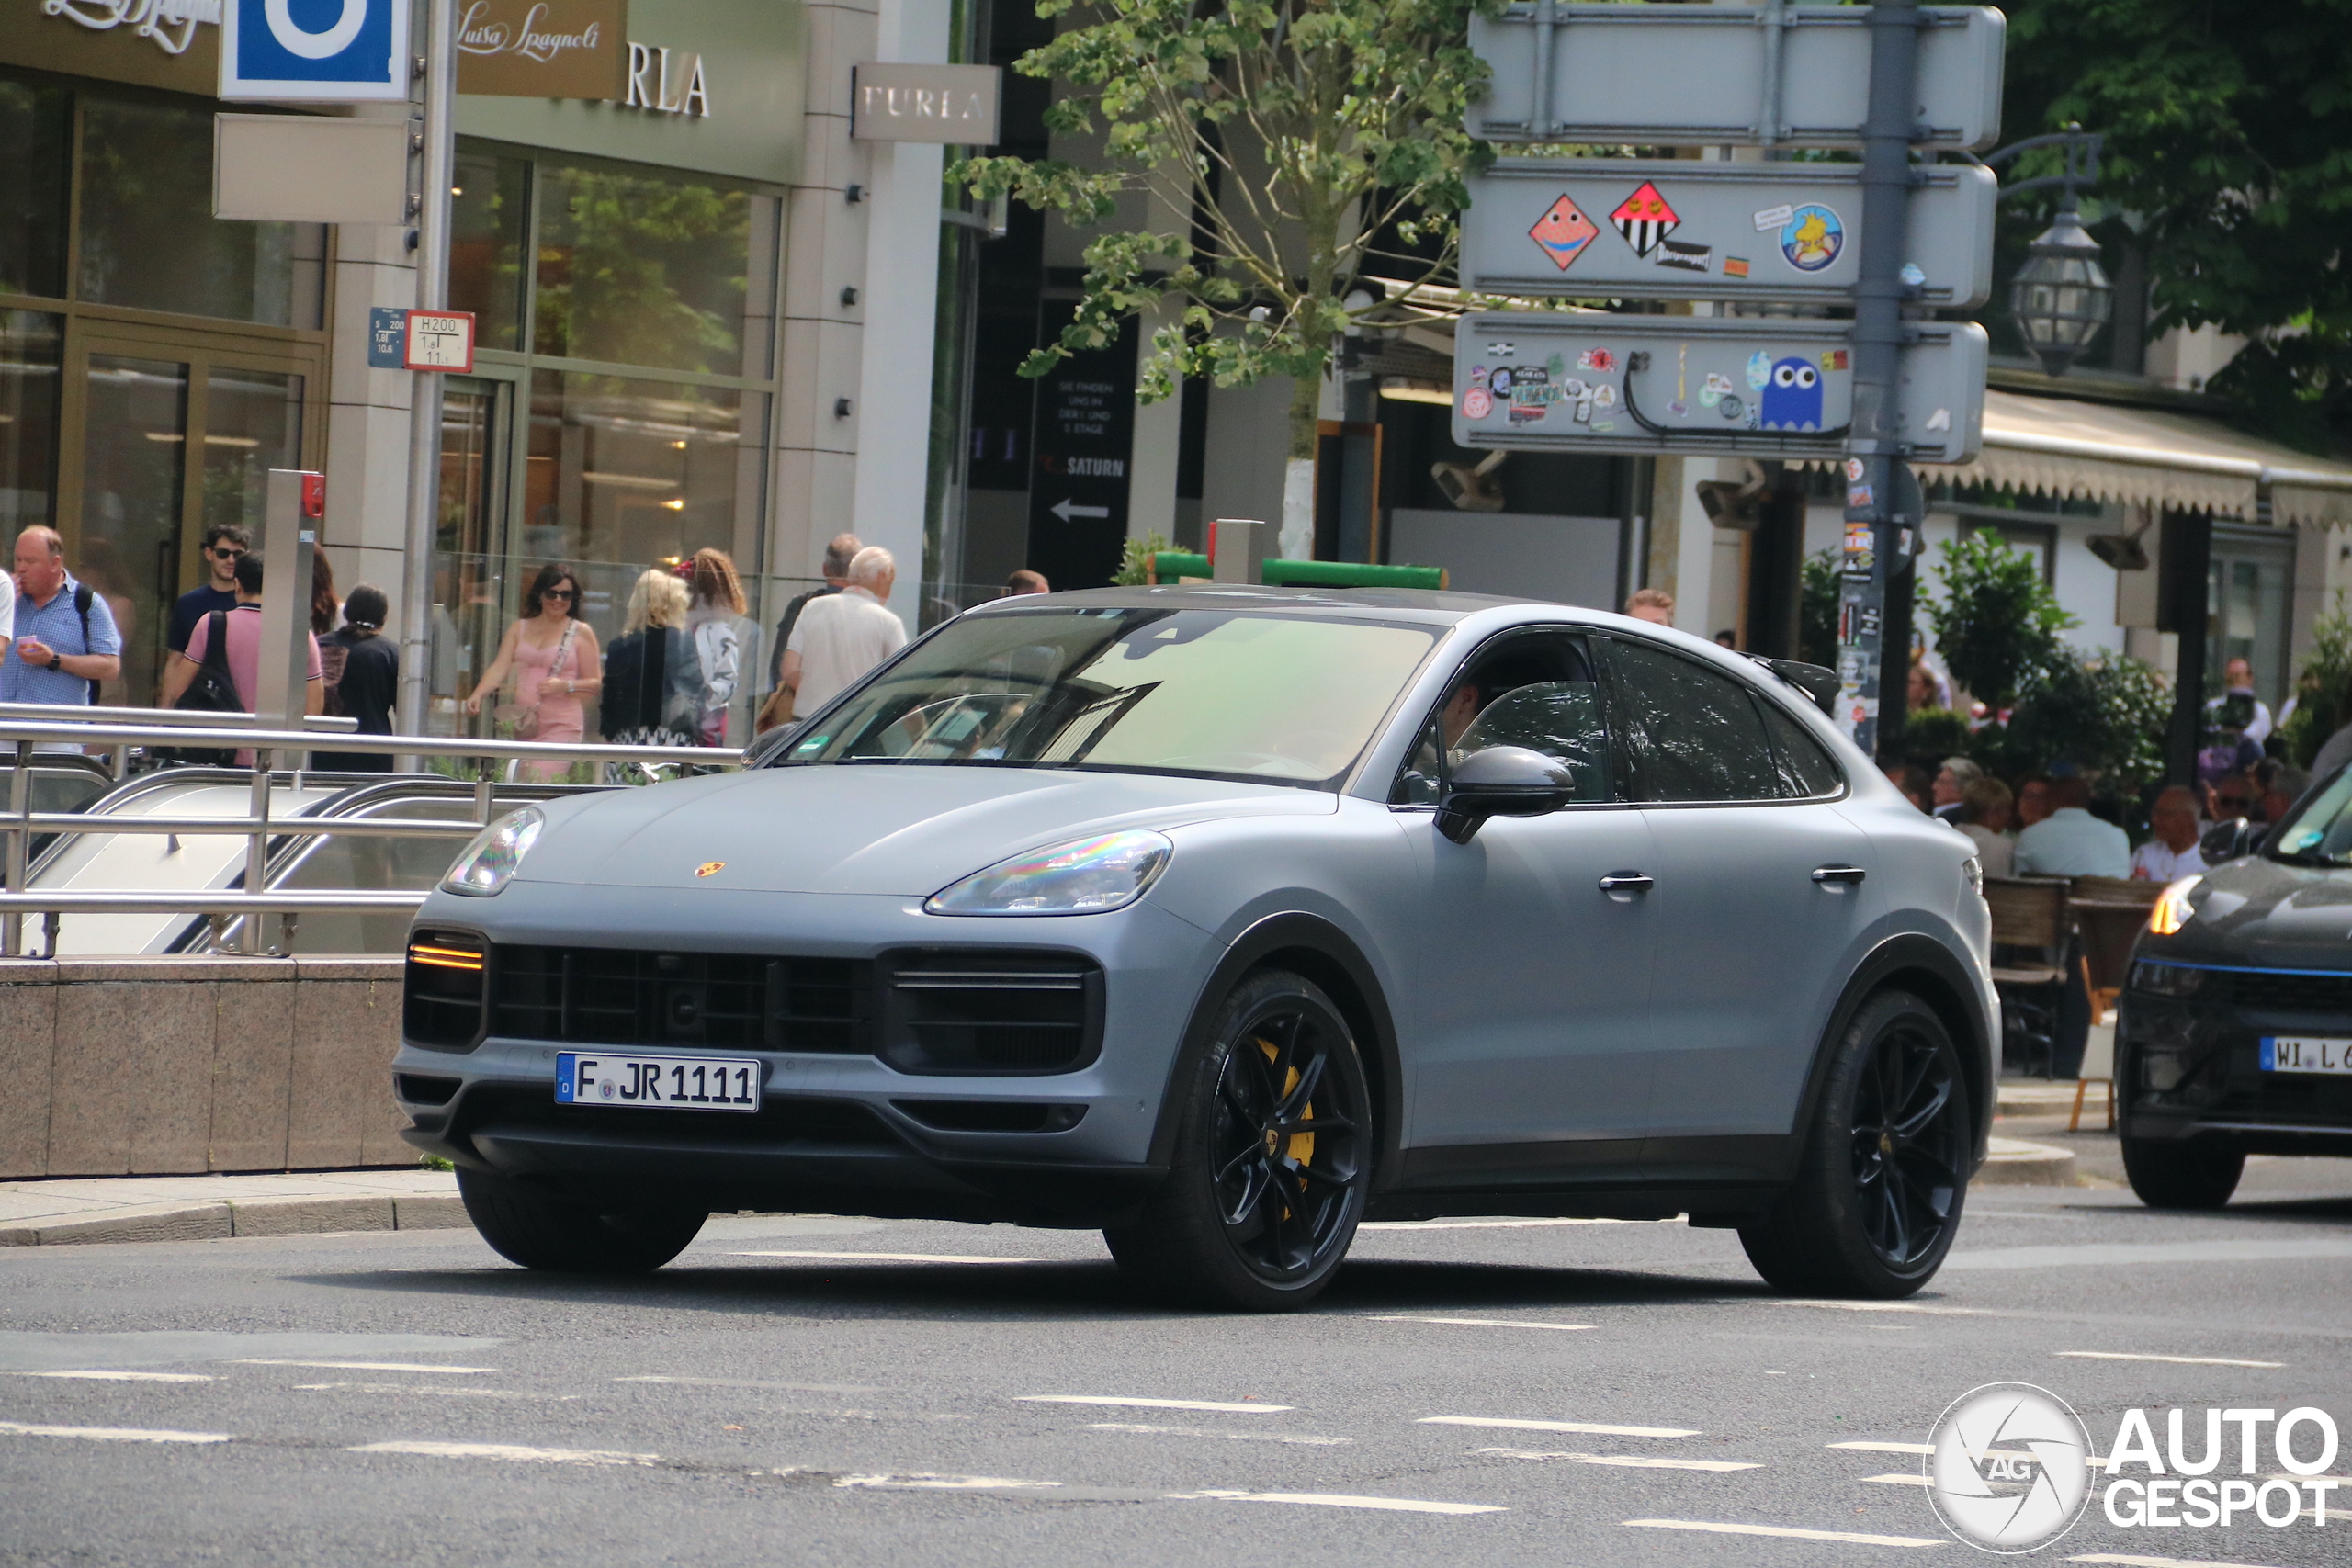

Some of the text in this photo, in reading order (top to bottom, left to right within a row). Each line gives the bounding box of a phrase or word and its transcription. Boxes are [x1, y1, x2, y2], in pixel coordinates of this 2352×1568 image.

[458, 0, 600, 62] Luisa Spagnoli
[626, 41, 710, 118] RLA
[390, 321, 404, 330] 200
[422, 318, 456, 332] H200
[375, 333, 385, 343] 1.8
[421, 335, 435, 350] 1.8
[377, 344, 393, 354] 10.6
[426, 351, 448, 365] 11.1
[1077, 383, 1113, 392] FINDEN
[1069, 396, 1102, 406] UNS IN
[1058, 409, 1079, 419] DER
[1088, 411, 1111, 421] UND
[1074, 423, 1103, 434] ETAGE
[1068, 457, 1124, 477] SATURN
[2278, 1043, 2301, 1067] WI
[2322, 1043, 2335, 1068] L
[561, 1083, 570, 1093] D
[577, 1061, 752, 1104] F JR 1111
